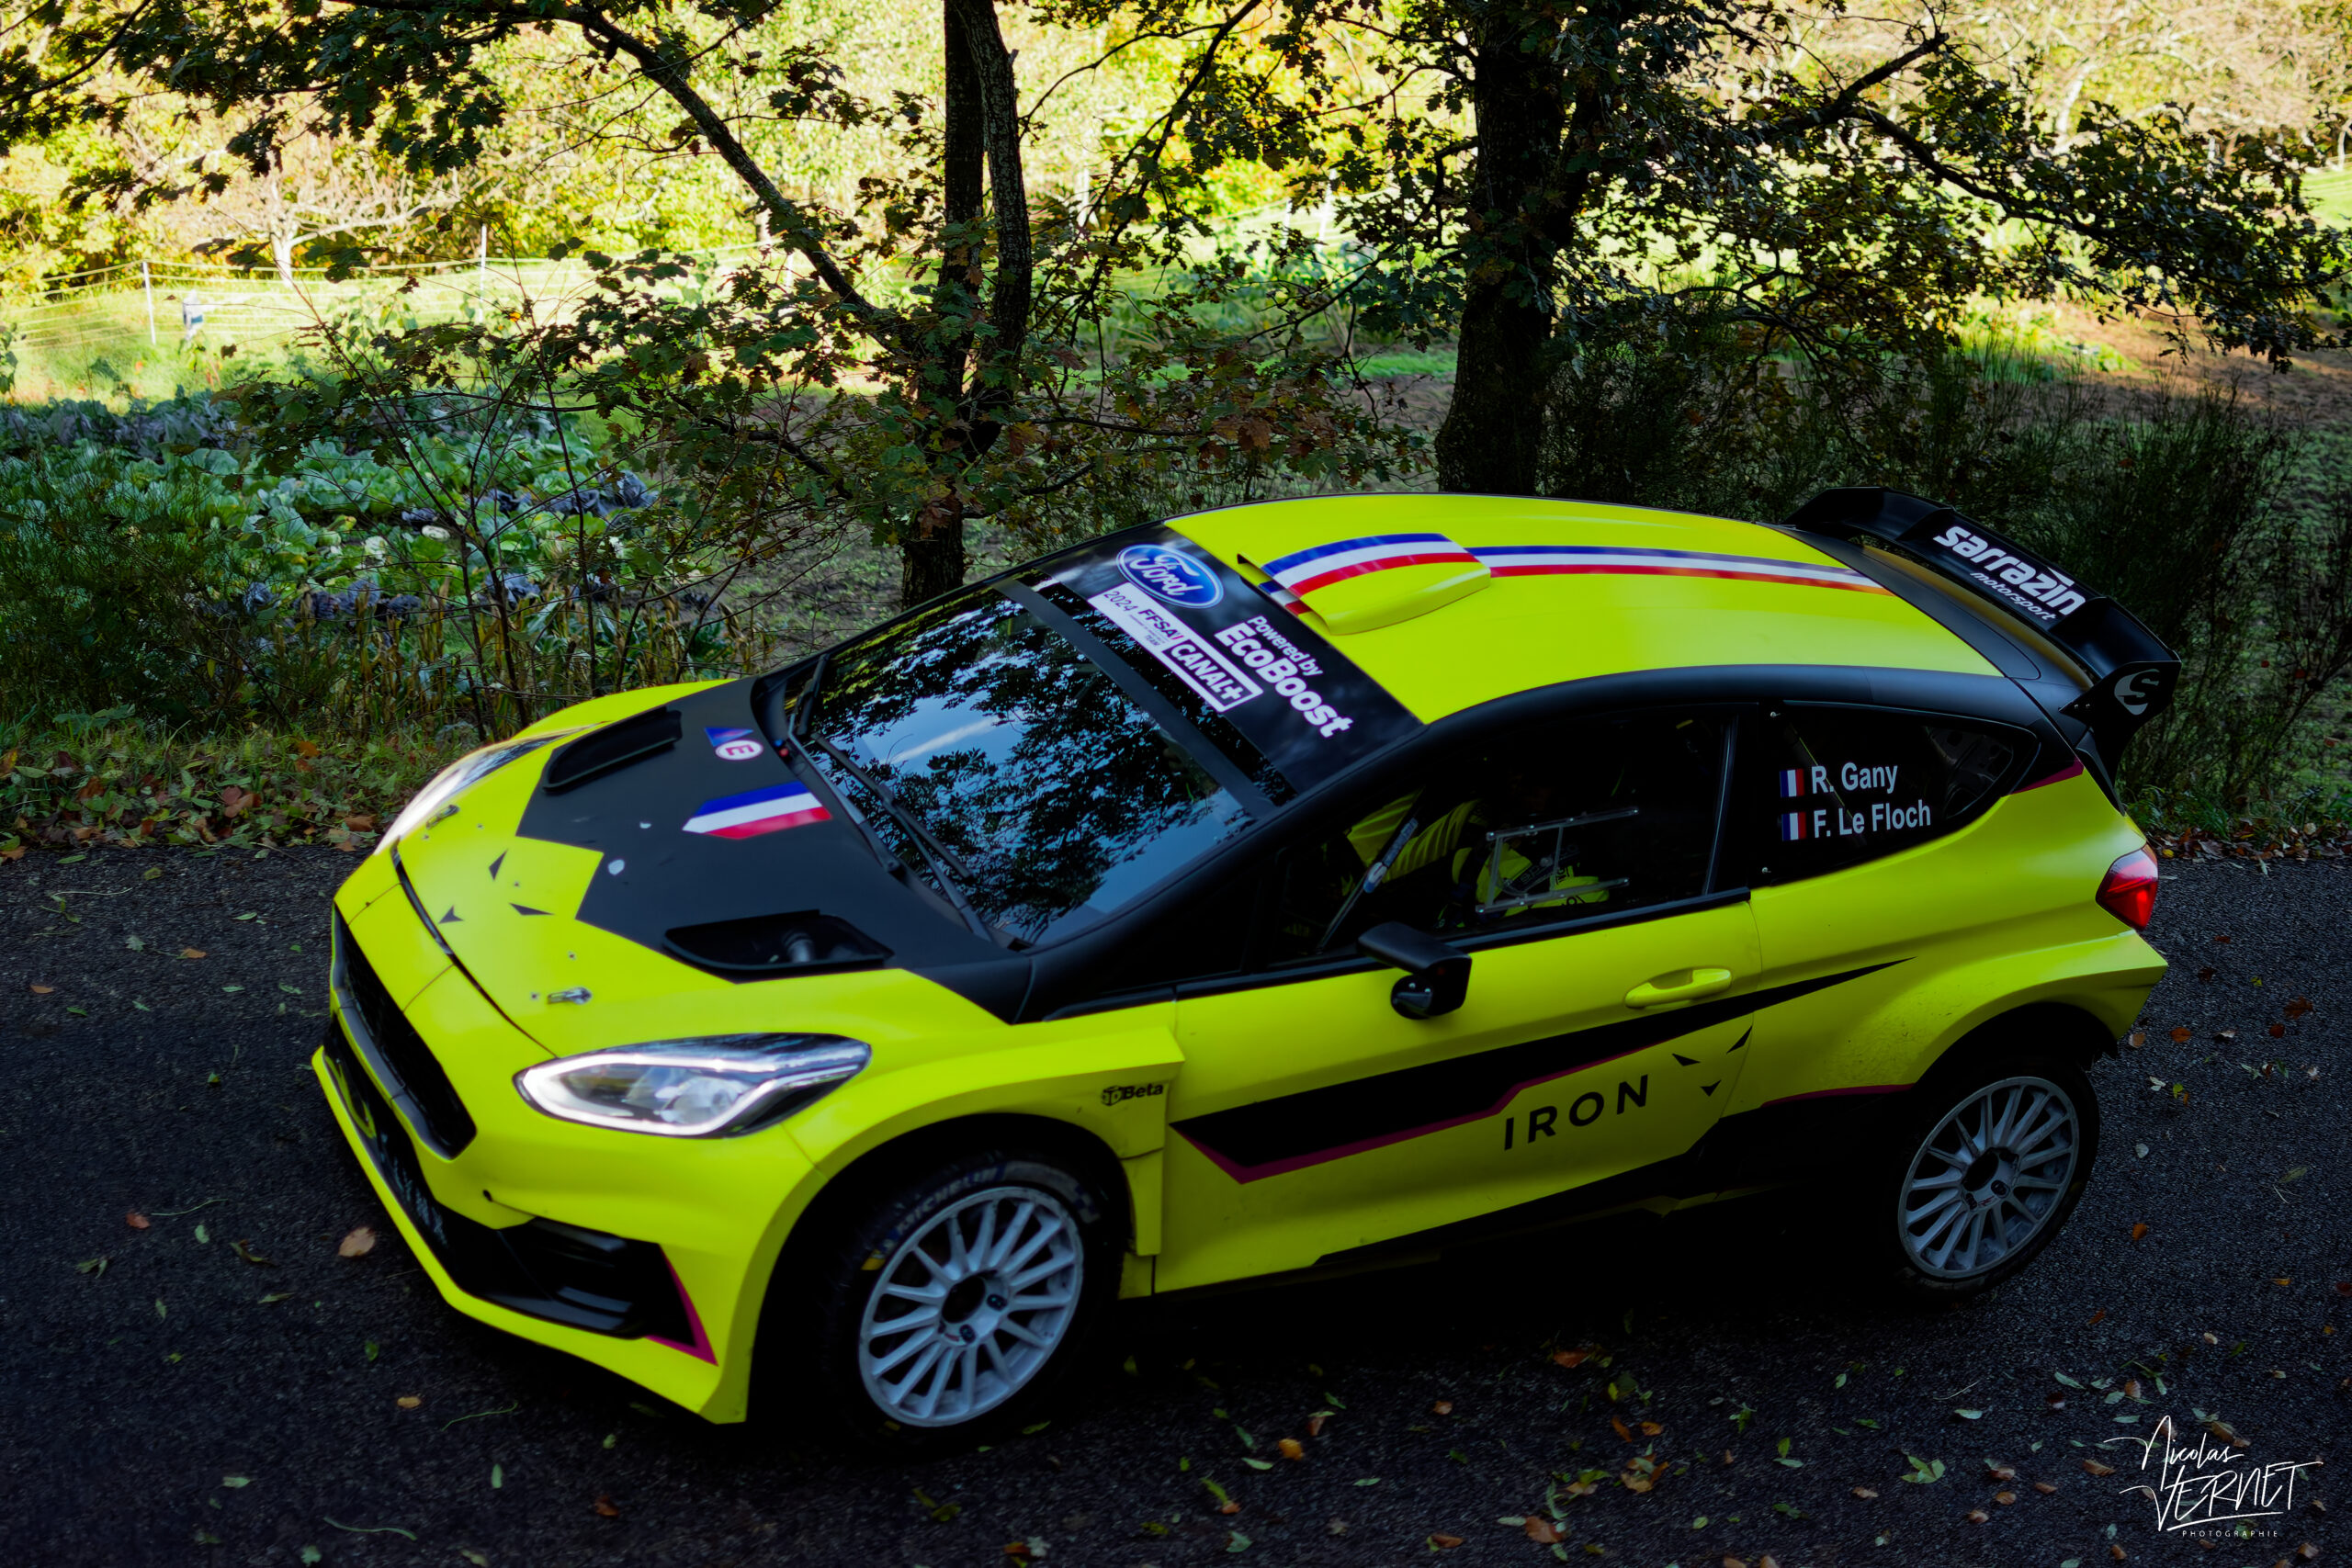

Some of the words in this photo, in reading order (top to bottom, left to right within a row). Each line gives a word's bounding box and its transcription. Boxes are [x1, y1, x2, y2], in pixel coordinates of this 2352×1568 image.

[1128, 554, 1204, 595] Ford
[1932, 525, 2086, 615] sarrazin
[1969, 571, 2056, 621] motorsport
[1103, 591, 1138, 612] 2024
[1137, 608, 1179, 639] FFSA
[1170, 643, 1244, 700] CANAL+
[1247, 615, 1310, 663] Powered
[1298, 658, 1324, 677] by
[1811, 764, 1835, 795] R.
[1841, 761, 1898, 795] Gany
[1813, 808, 1831, 839] F.
[1838, 807, 1865, 836] Le
[1871, 798, 1931, 832] Floch
[1123, 1082, 1164, 1100] Beta
[1504, 1073, 1649, 1152] IRON
